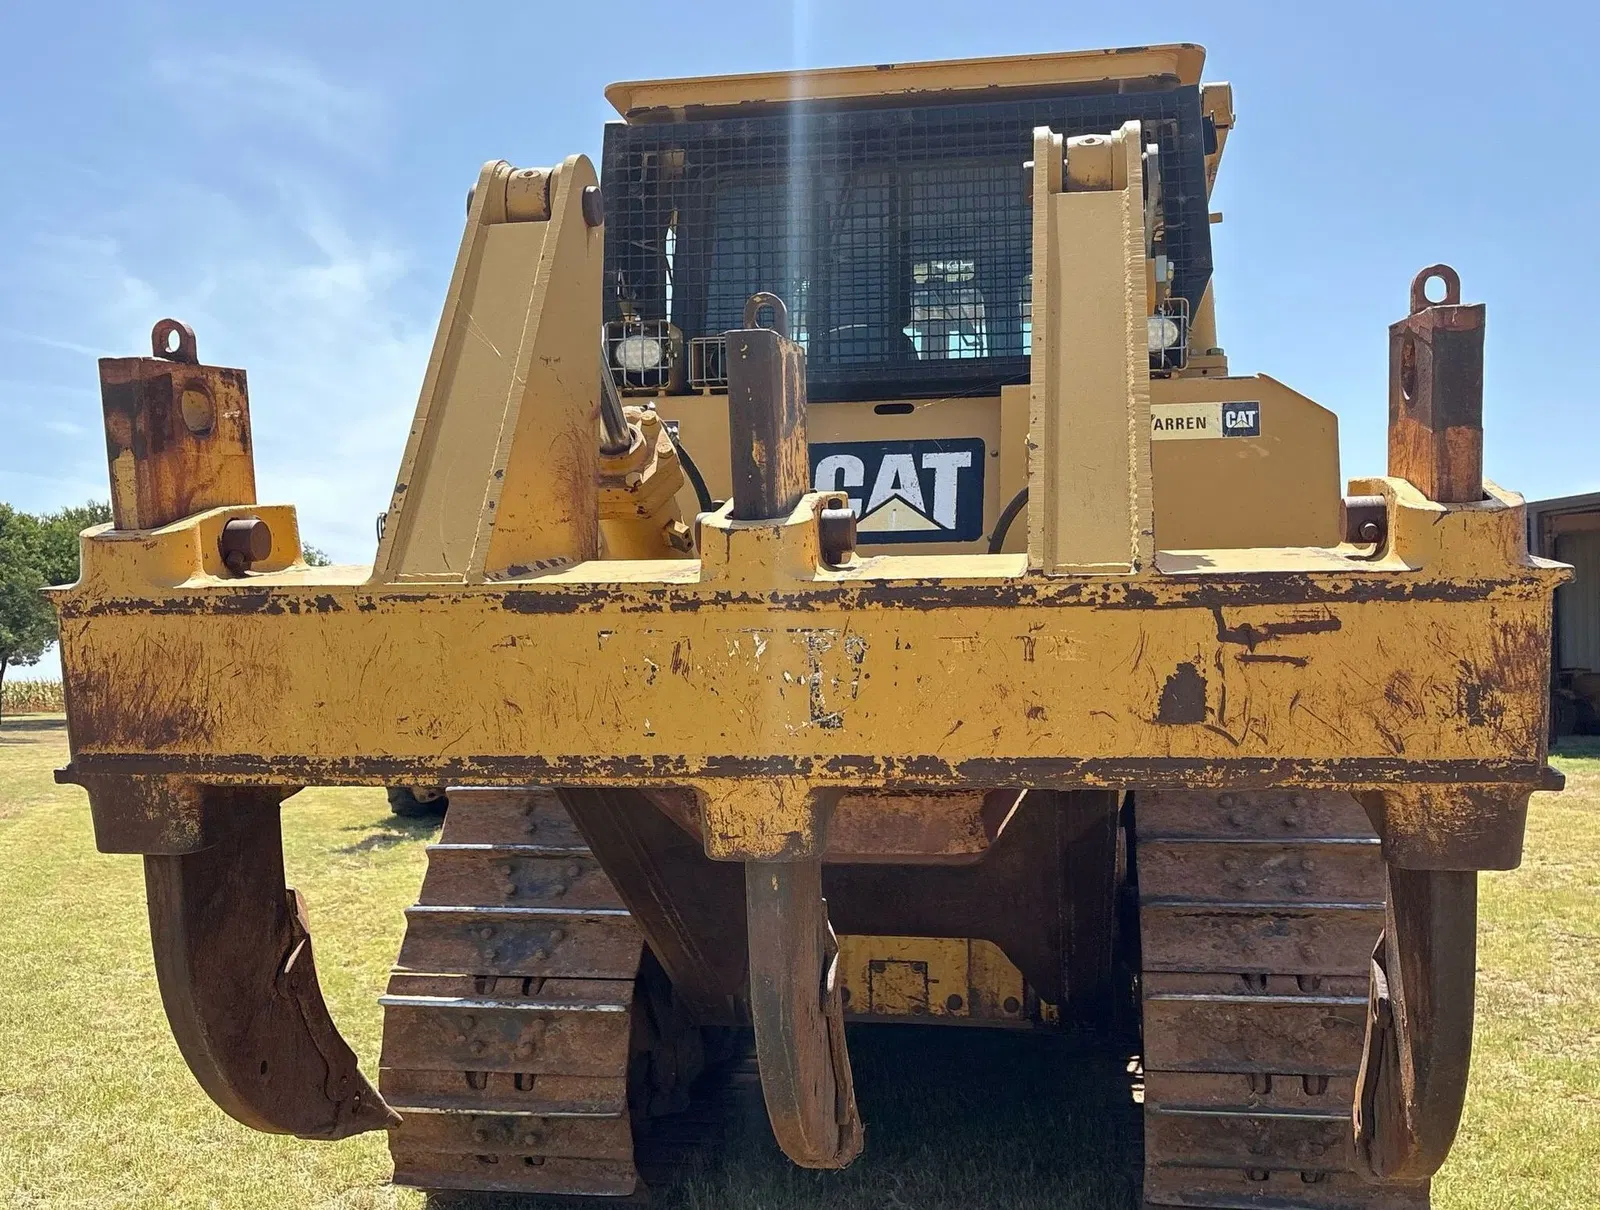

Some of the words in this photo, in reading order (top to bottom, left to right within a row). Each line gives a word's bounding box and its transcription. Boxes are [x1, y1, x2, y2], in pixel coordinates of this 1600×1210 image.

[1151, 414, 1206, 430] ARREN
[1225, 411, 1256, 428] CAT
[815, 452, 971, 530] CAT
